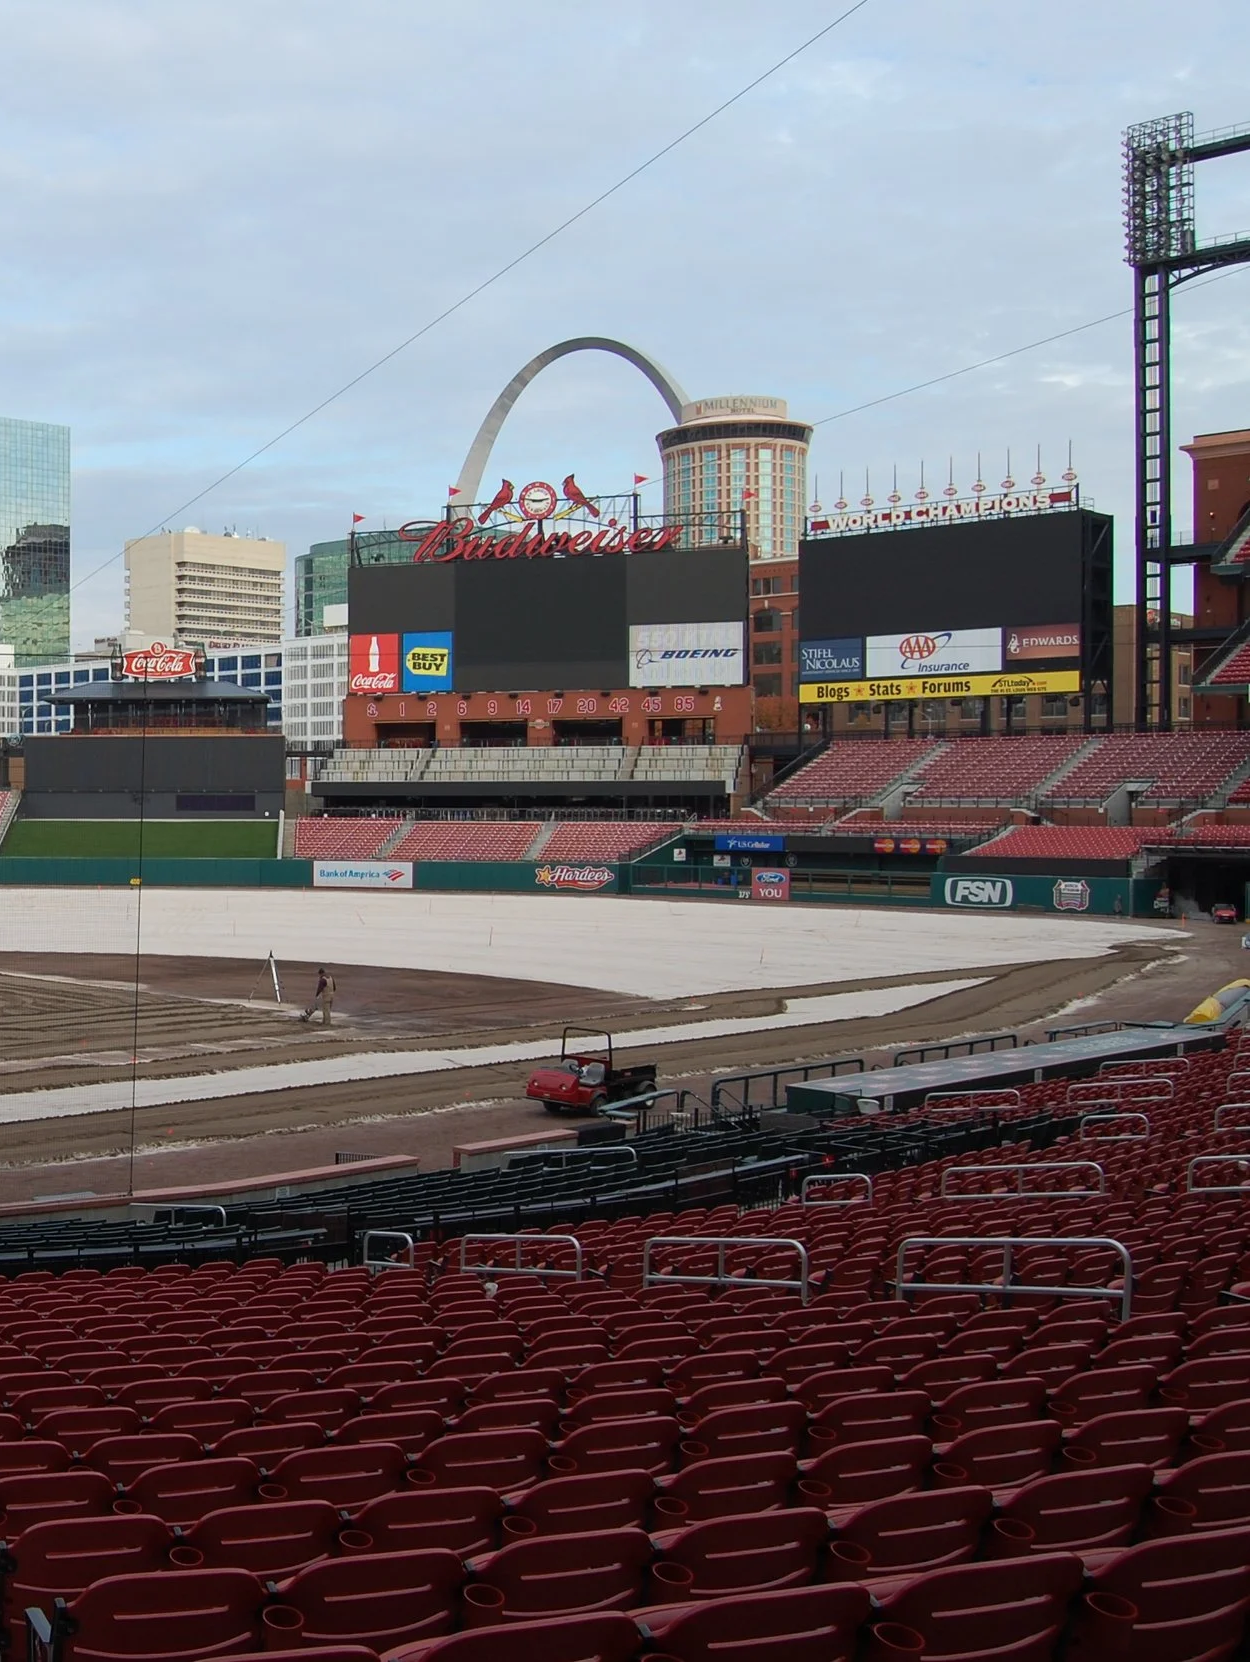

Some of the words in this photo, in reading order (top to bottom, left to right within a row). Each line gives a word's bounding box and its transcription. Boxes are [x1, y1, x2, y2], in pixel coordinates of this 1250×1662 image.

[704, 398, 778, 410] MILLENNIUM
[827, 510, 905, 532] WORLD
[910, 493, 1051, 522] CHAMPIONS
[398, 517, 684, 563] Budweiser
[902, 635, 934, 659] AAA
[411, 652, 447, 662] BEST
[660, 648, 740, 659] BOEING
[801, 648, 834, 660] STIFEL
[412, 662, 444, 671] BUY
[805, 657, 860, 671] NICOLAUS
[917, 662, 970, 673] Insurance
[817, 685, 850, 700] Blogs
[869, 683, 902, 696] Stats
[921, 680, 971, 694] Forums
[399, 702, 406, 717] 1
[426, 701, 437, 716] 2
[457, 701, 467, 715] 6
[487, 700, 498, 715] 9
[516, 699, 531, 714] 14
[547, 698, 563, 714] 17
[576, 698, 596, 714] 20
[608, 697, 630, 713] 42
[641, 696, 662, 712] 45
[673, 696, 694, 712] 85
[319, 869, 340, 878] Bank
[340, 869, 348, 878] of
[349, 869, 380, 879] America
[758, 873, 781, 884] Ford
[759, 888, 783, 898] YOU
[954, 880, 1002, 904] FSN
